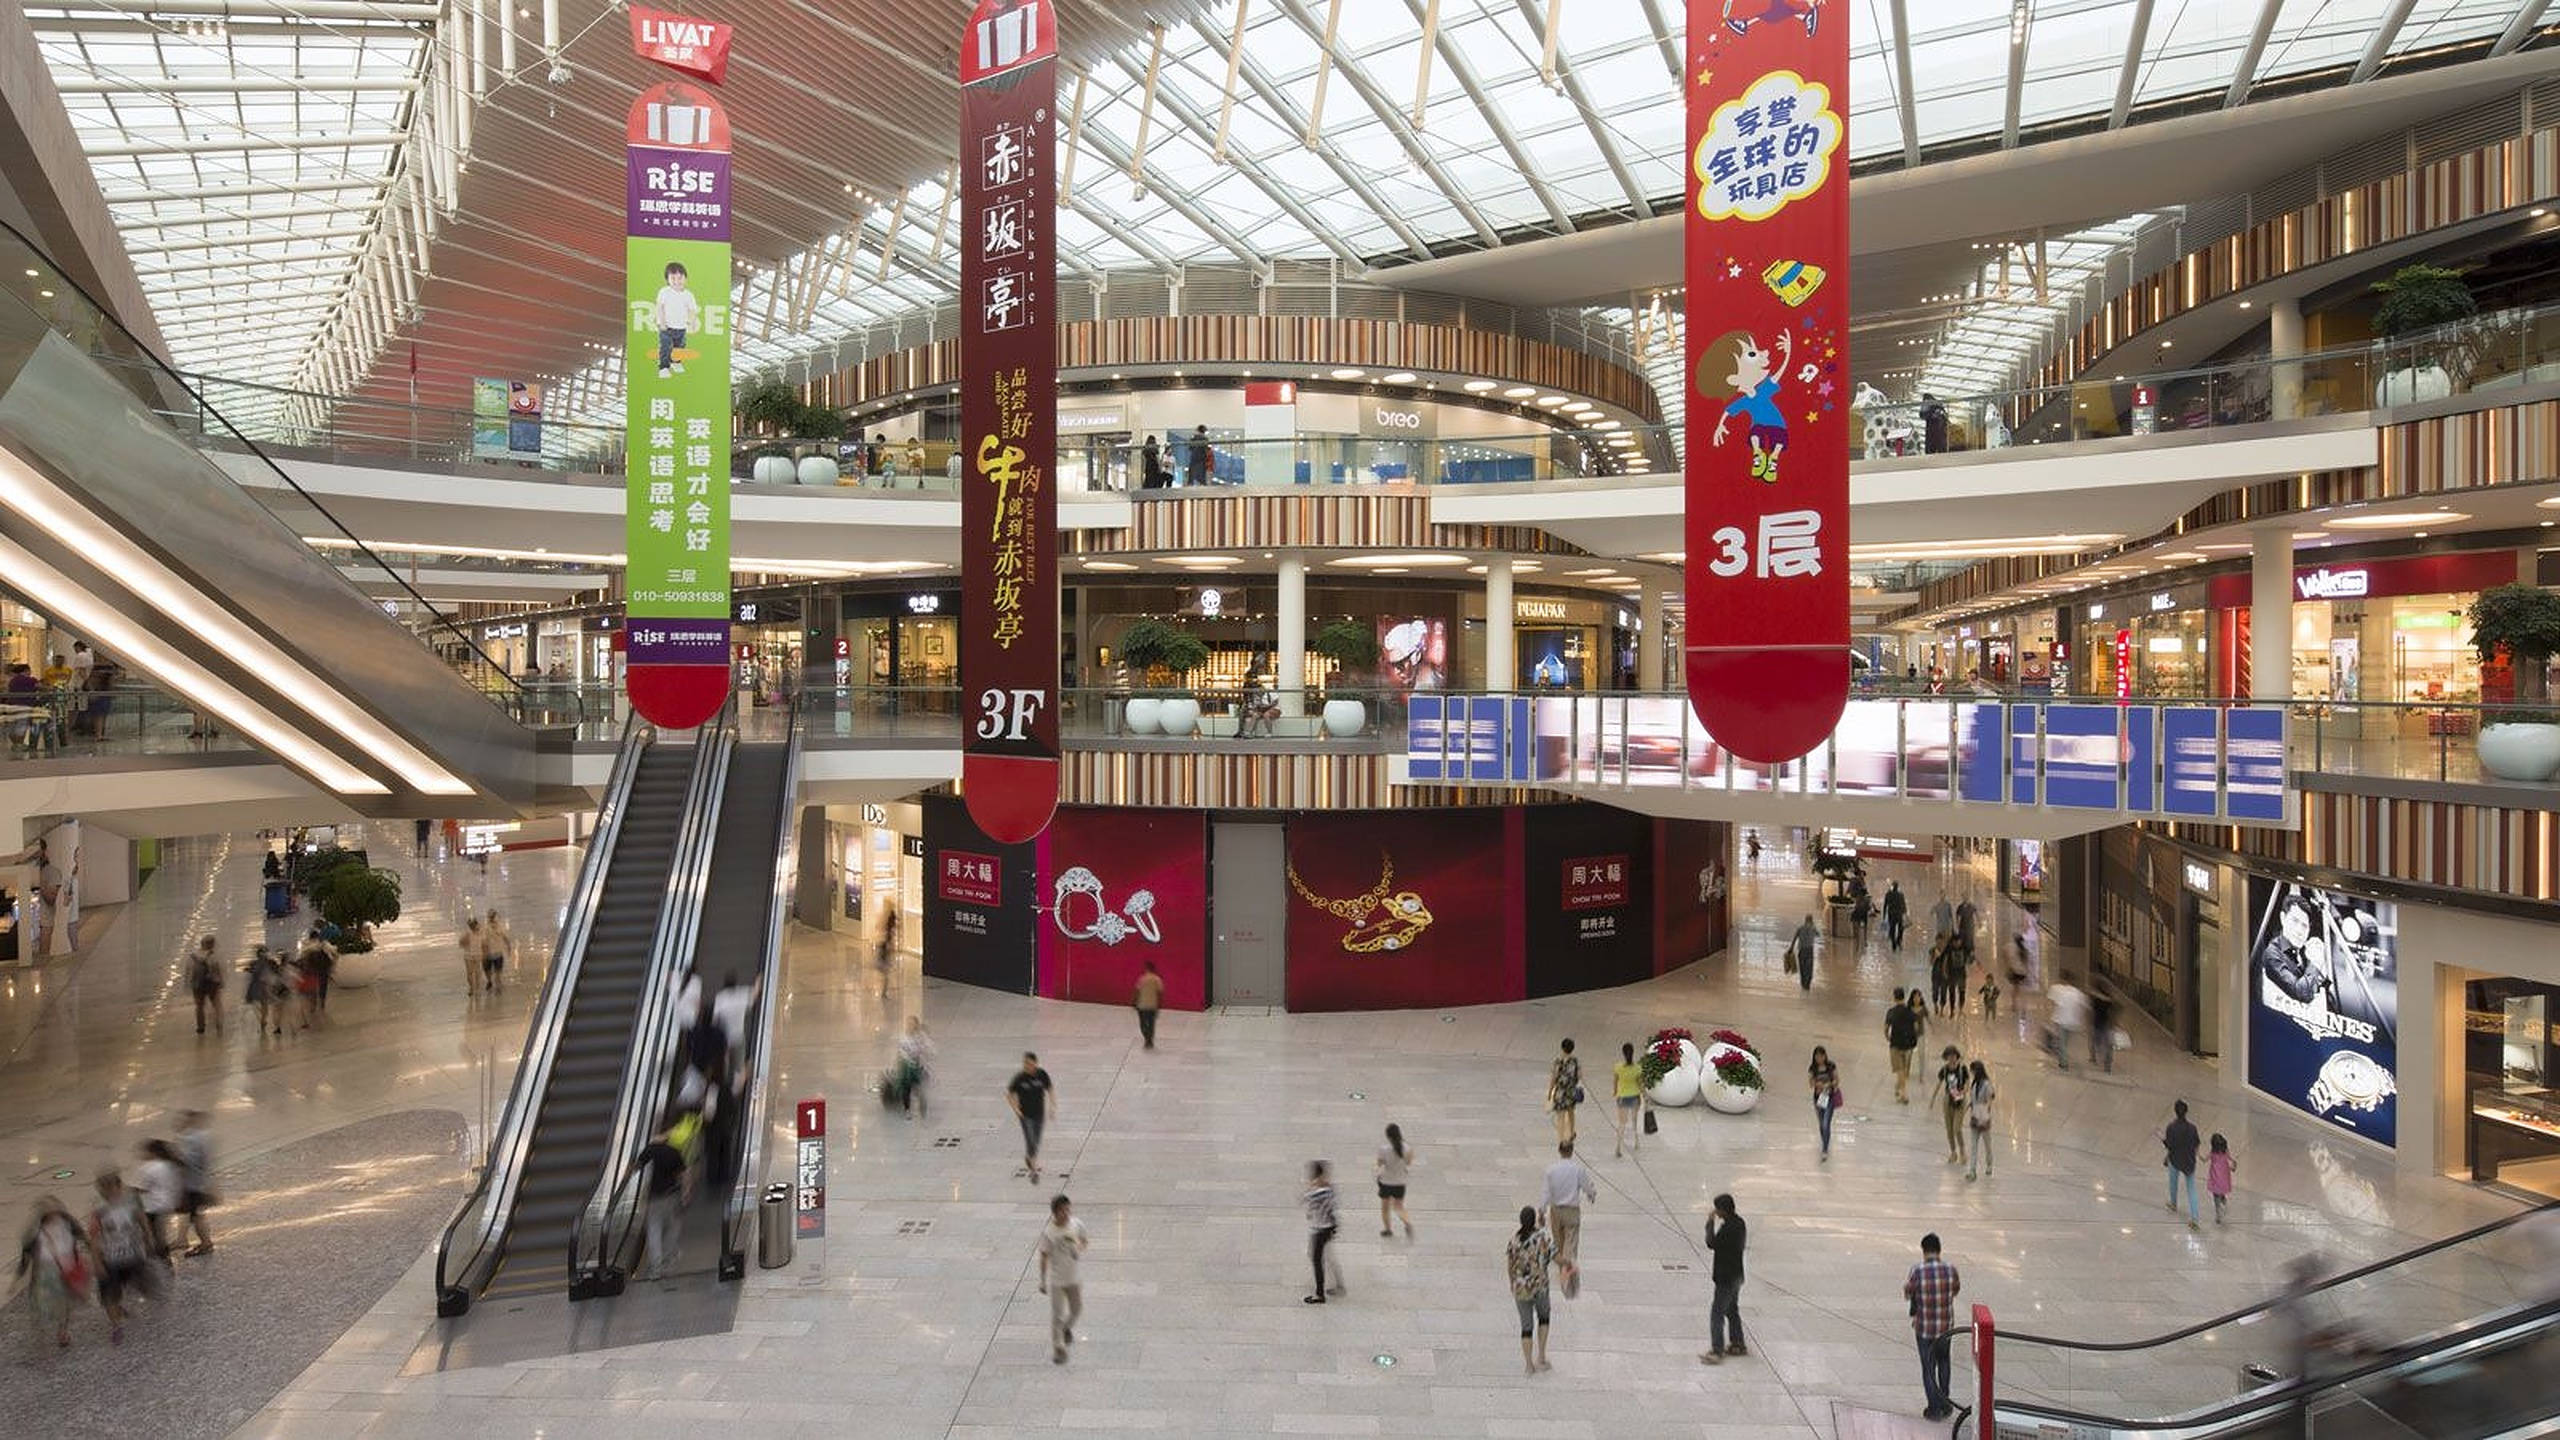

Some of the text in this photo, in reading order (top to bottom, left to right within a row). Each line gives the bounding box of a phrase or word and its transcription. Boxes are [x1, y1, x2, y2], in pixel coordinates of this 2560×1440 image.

[642, 19, 715, 47] LIVAT
[1733, 96, 1798, 137] 享誉
[1706, 122, 1820, 185] 全球的
[1727, 161, 1809, 203] 玩具店
[985, 133, 1021, 329] 赤坂亭
[1026, 124, 1036, 325] Akasakatei
[1376, 406, 1420, 429] breo
[649, 397, 675, 533] 用英语思考
[686, 417, 712, 552] 英语才会好
[1709, 509, 1823, 579] 3层
[666, 568, 697, 583] 三层
[838, 641, 847, 654] 2
[976, 688, 1046, 741] 3F
[947, 858, 993, 883] 周大福
[1572, 863, 1621, 886] 周大福
[806, 1108, 817, 1131] 1
